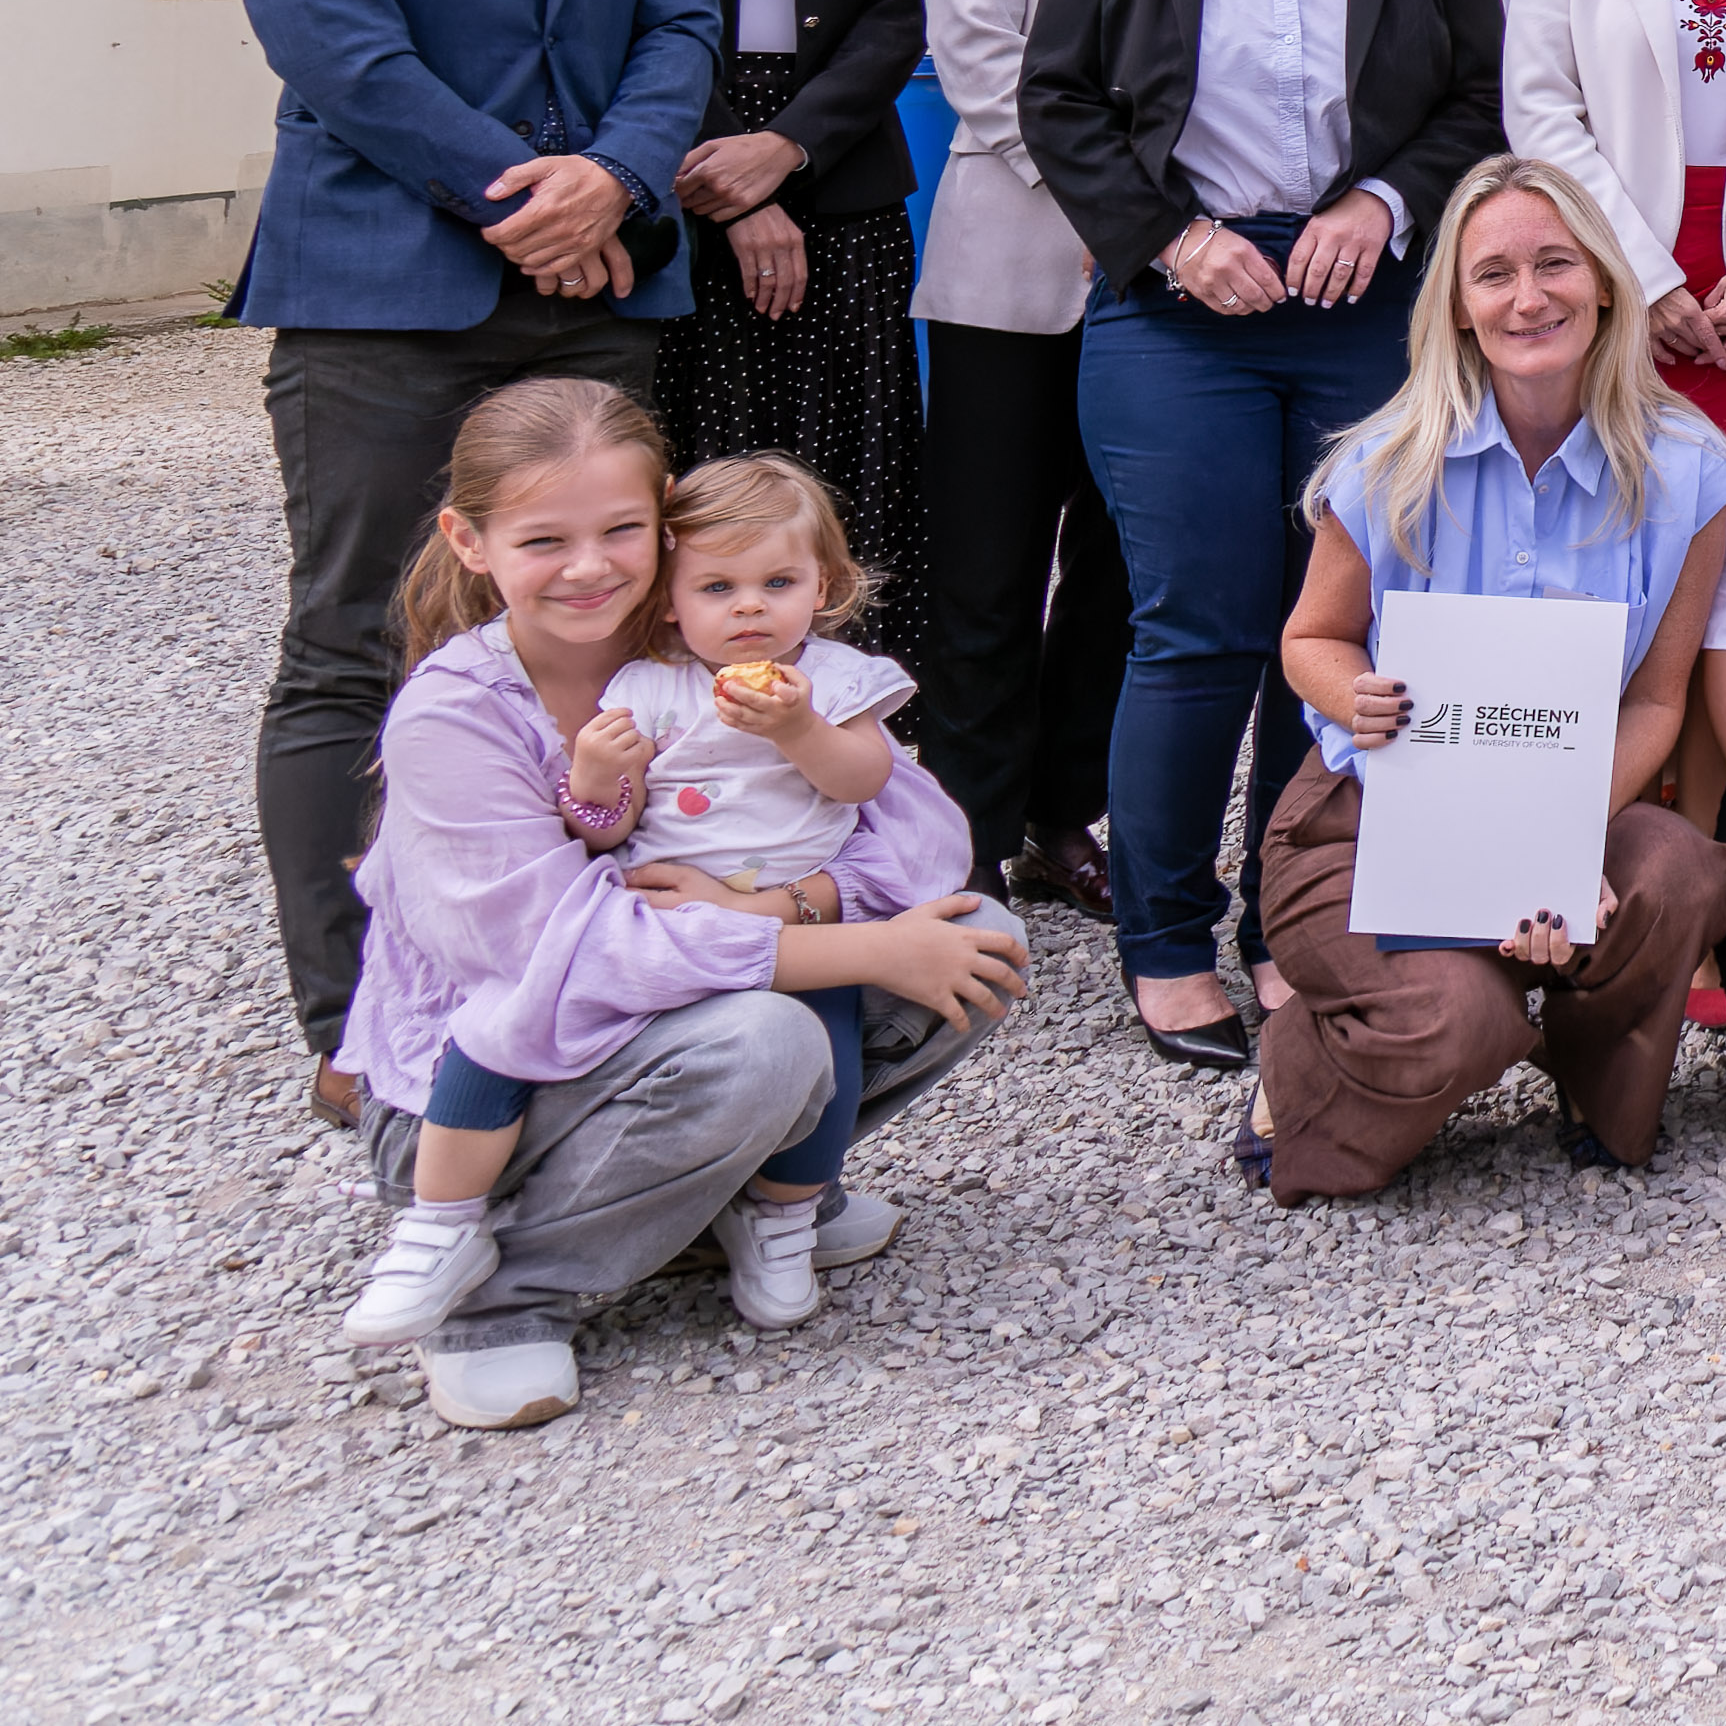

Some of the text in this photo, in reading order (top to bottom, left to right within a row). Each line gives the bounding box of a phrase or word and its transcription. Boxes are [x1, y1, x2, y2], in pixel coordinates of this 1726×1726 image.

[1476, 703, 1579, 724] SZÉCHENYI
[1473, 721, 1560, 739] EGYETEM
[1472, 738, 1521, 748] UNIVERSITY
[1522, 740, 1533, 748] OF
